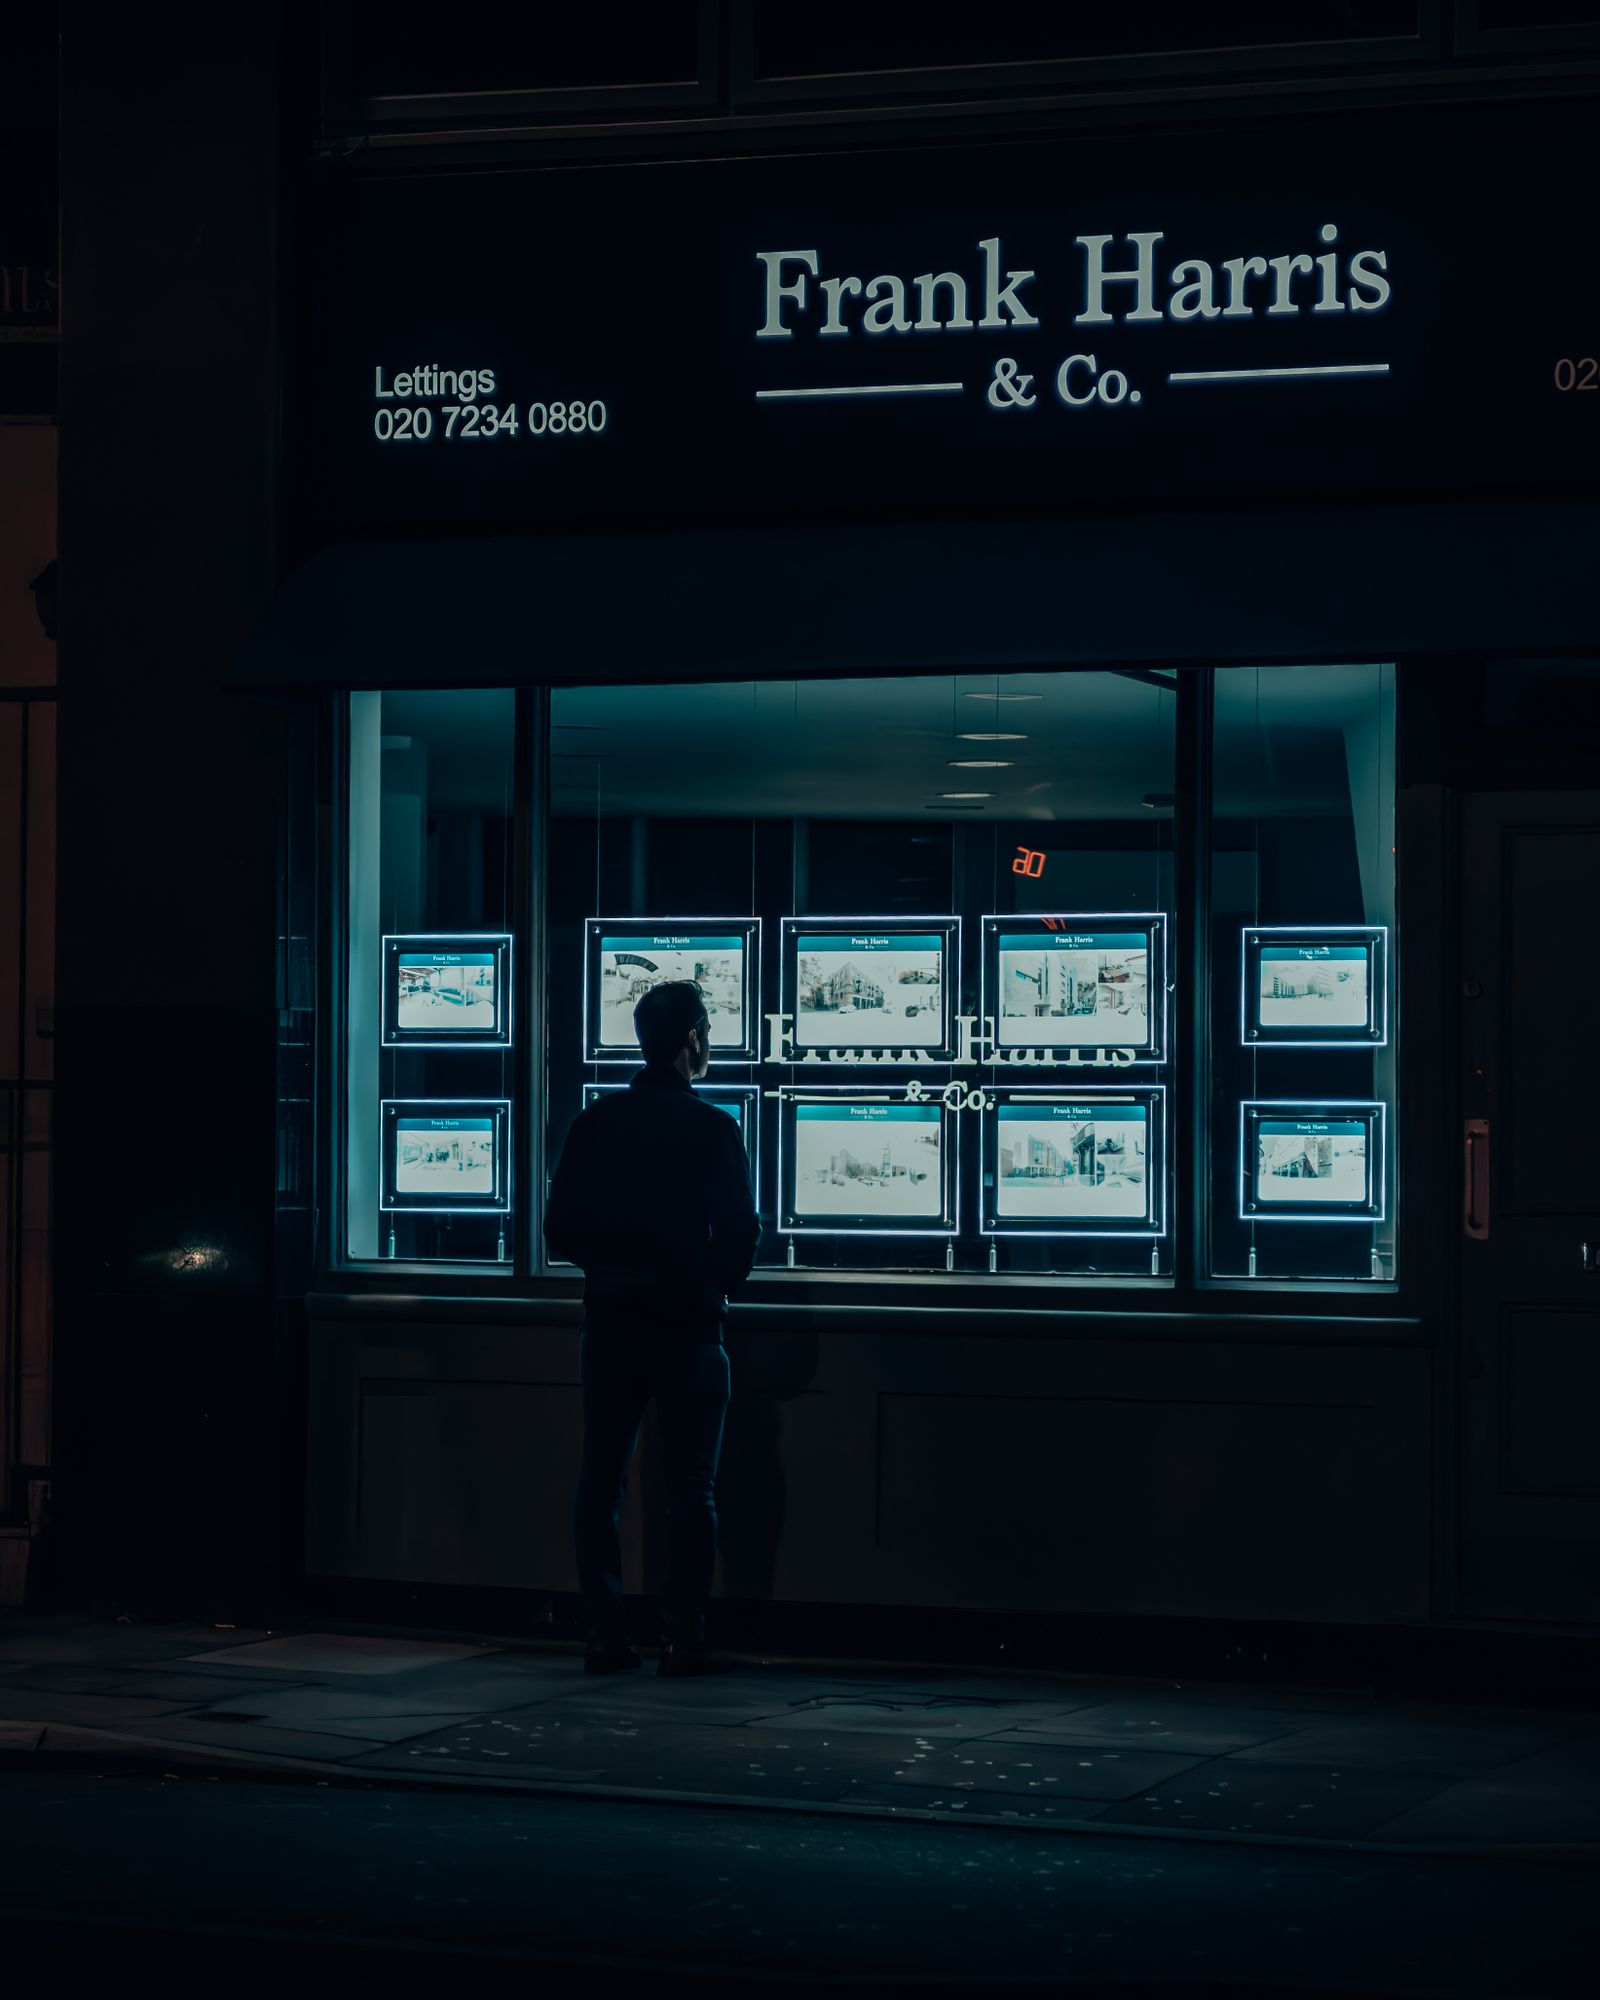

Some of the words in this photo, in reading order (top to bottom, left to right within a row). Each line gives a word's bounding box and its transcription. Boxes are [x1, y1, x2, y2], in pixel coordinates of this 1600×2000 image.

[756, 237, 1040, 338] Frank
[1073, 223, 1391, 325] Harris
[375, 363, 495, 402] Lettings
[987, 357, 1037, 408] &
[1056, 354, 1142, 406] Co.
[1554, 358, 1600, 391] 02
[374, 407, 432, 440] 020
[441, 404, 519, 438] 7234
[528, 400, 607, 434] 0880
[943, 1081, 994, 1110] Co.
